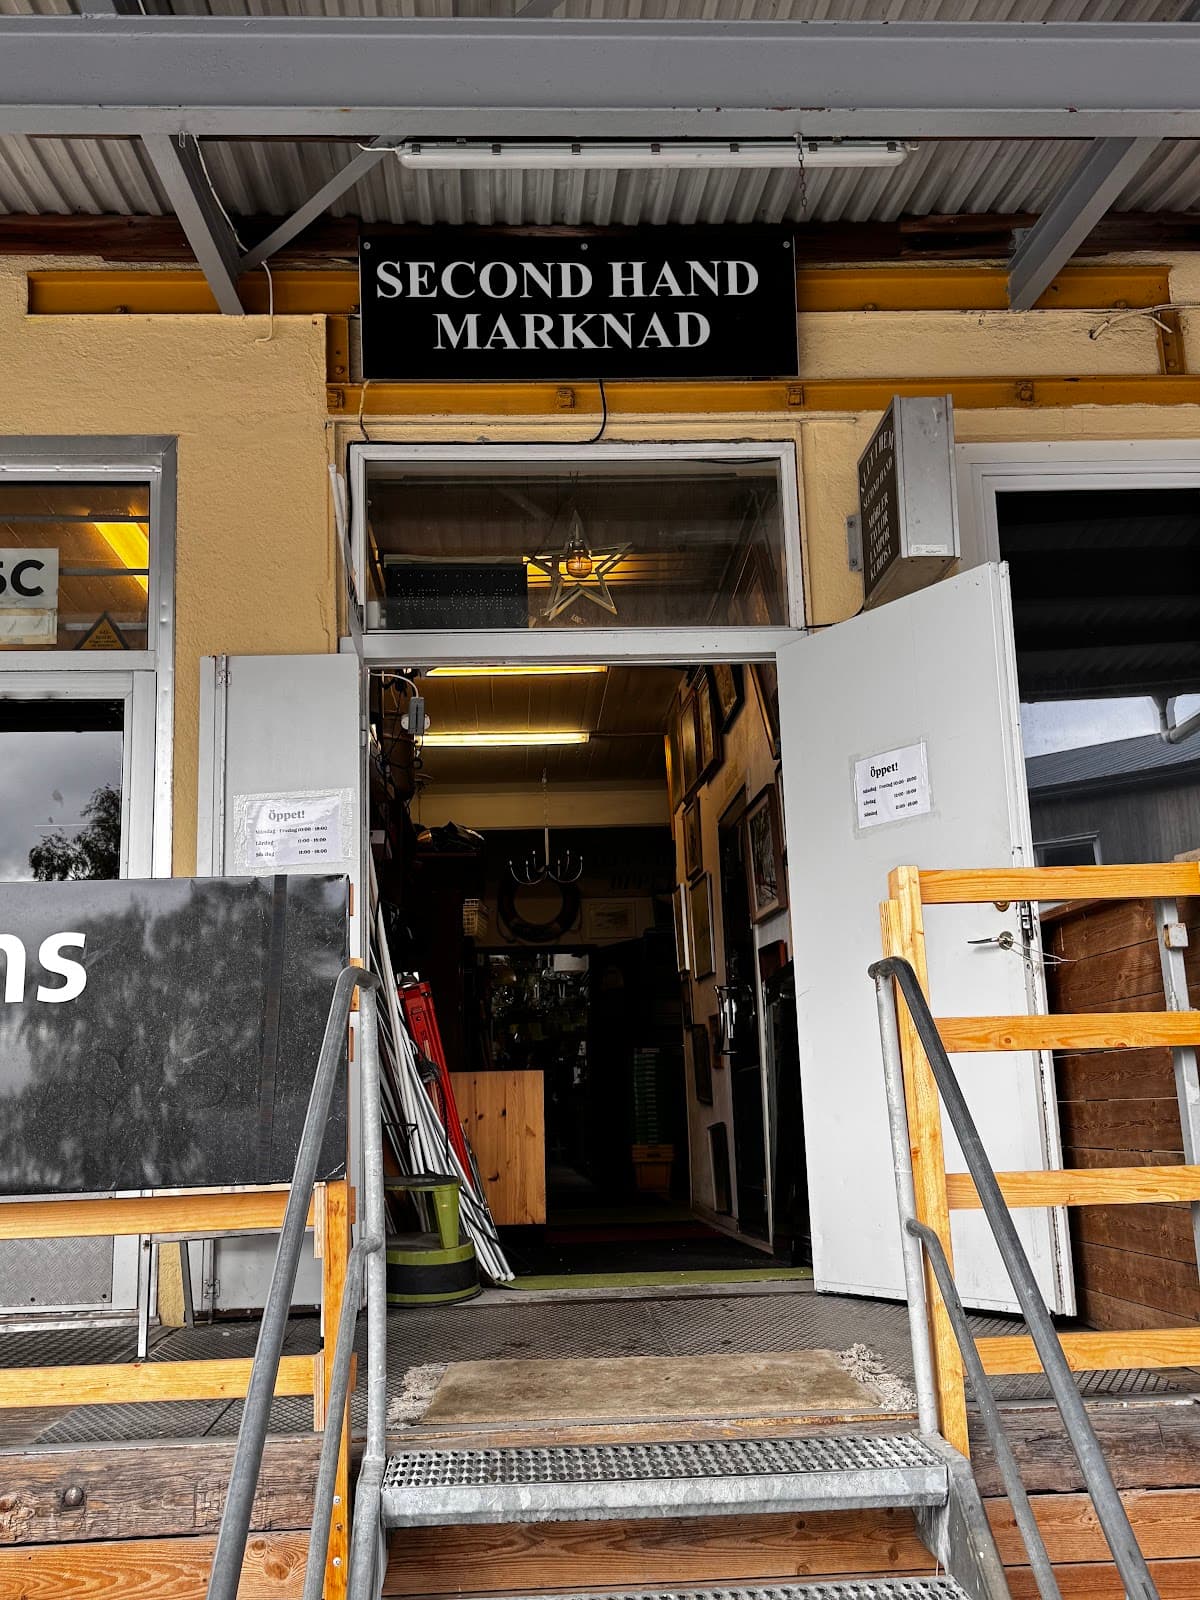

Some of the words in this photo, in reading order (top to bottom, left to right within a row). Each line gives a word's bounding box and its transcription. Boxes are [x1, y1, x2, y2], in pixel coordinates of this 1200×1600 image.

[376, 261, 593, 299] SECOND
[607, 260, 759, 297] HAND
[432, 311, 711, 350] MARKNAD
[870, 762, 898, 778] Öppet!
[268, 809, 305, 822] Öppet!
